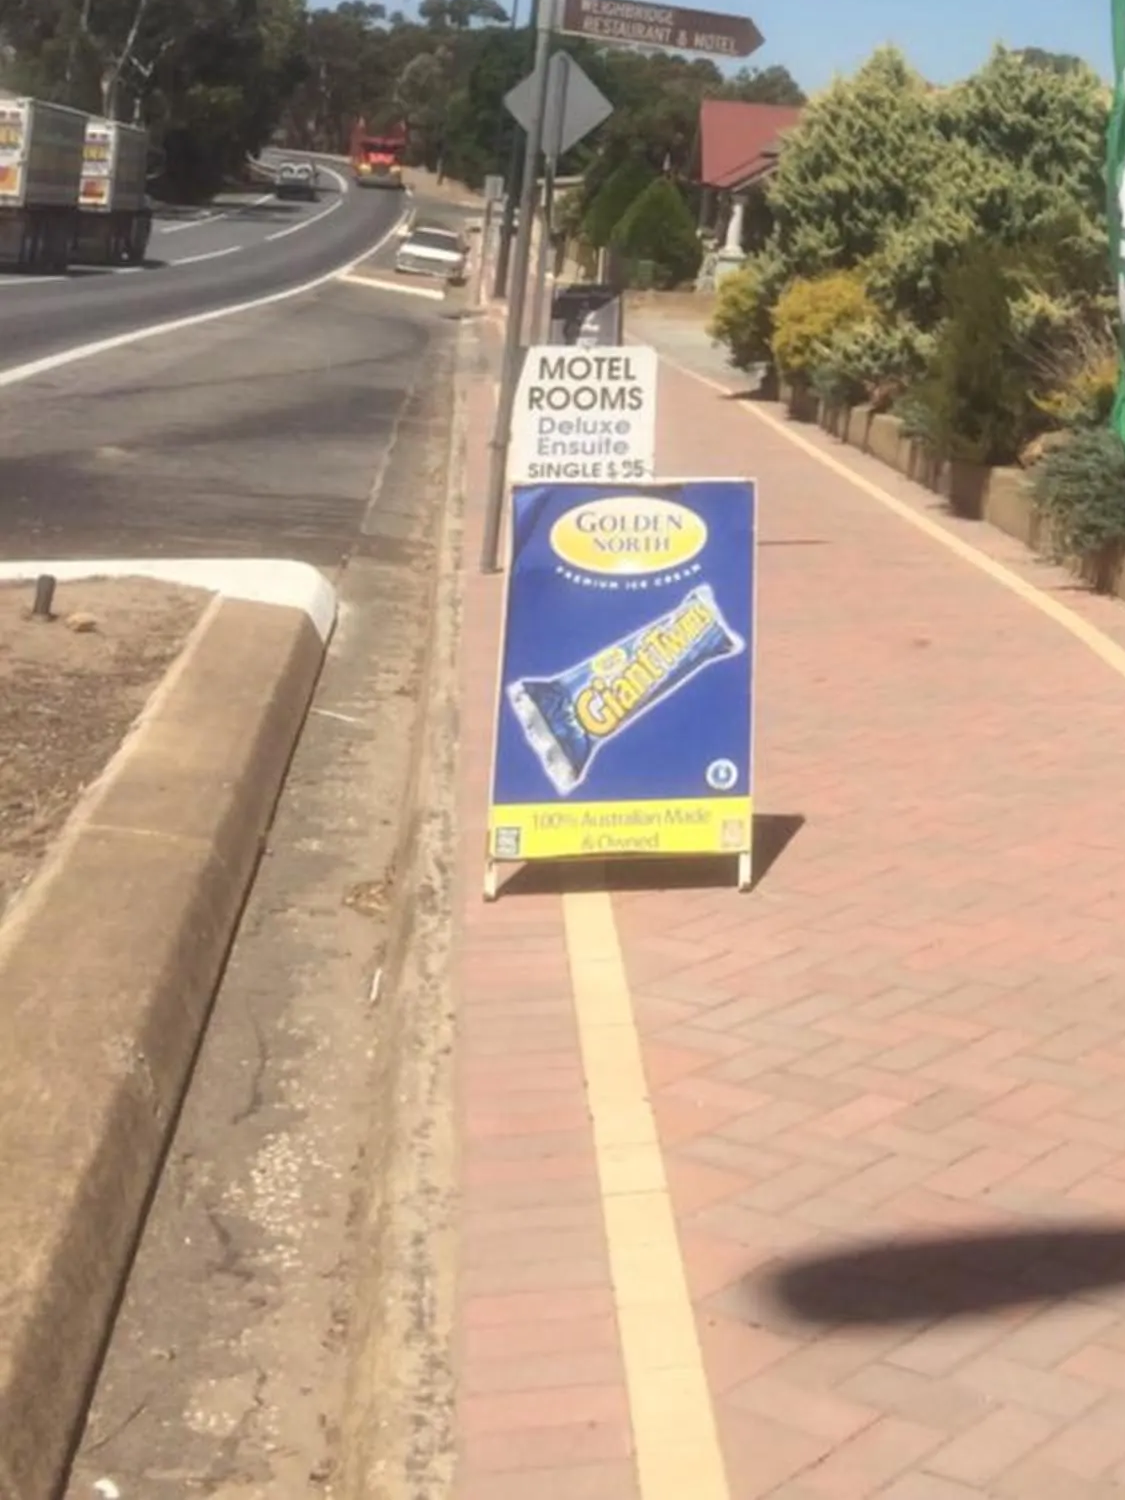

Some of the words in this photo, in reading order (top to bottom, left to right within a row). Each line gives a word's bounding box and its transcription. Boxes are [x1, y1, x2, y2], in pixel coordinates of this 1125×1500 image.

[581, 14, 672, 44] RESTAURANT
[676, 29, 688, 47] &
[693, 31, 737, 54] MOTEL
[538, 356, 637, 381] MOTEL
[528, 386, 644, 411] ROOMS
[537, 416, 631, 435] Deluxe
[537, 436, 630, 456] Ensuite
[527, 461, 602, 479] SINGLE
[575, 510, 684, 534] GOLDEN
[592, 536, 671, 554] NORTH
[575, 650, 664, 738] Giant
[581, 809, 661, 829] Australian
[664, 807, 711, 825] Made
[598, 832, 660, 850] Owned
